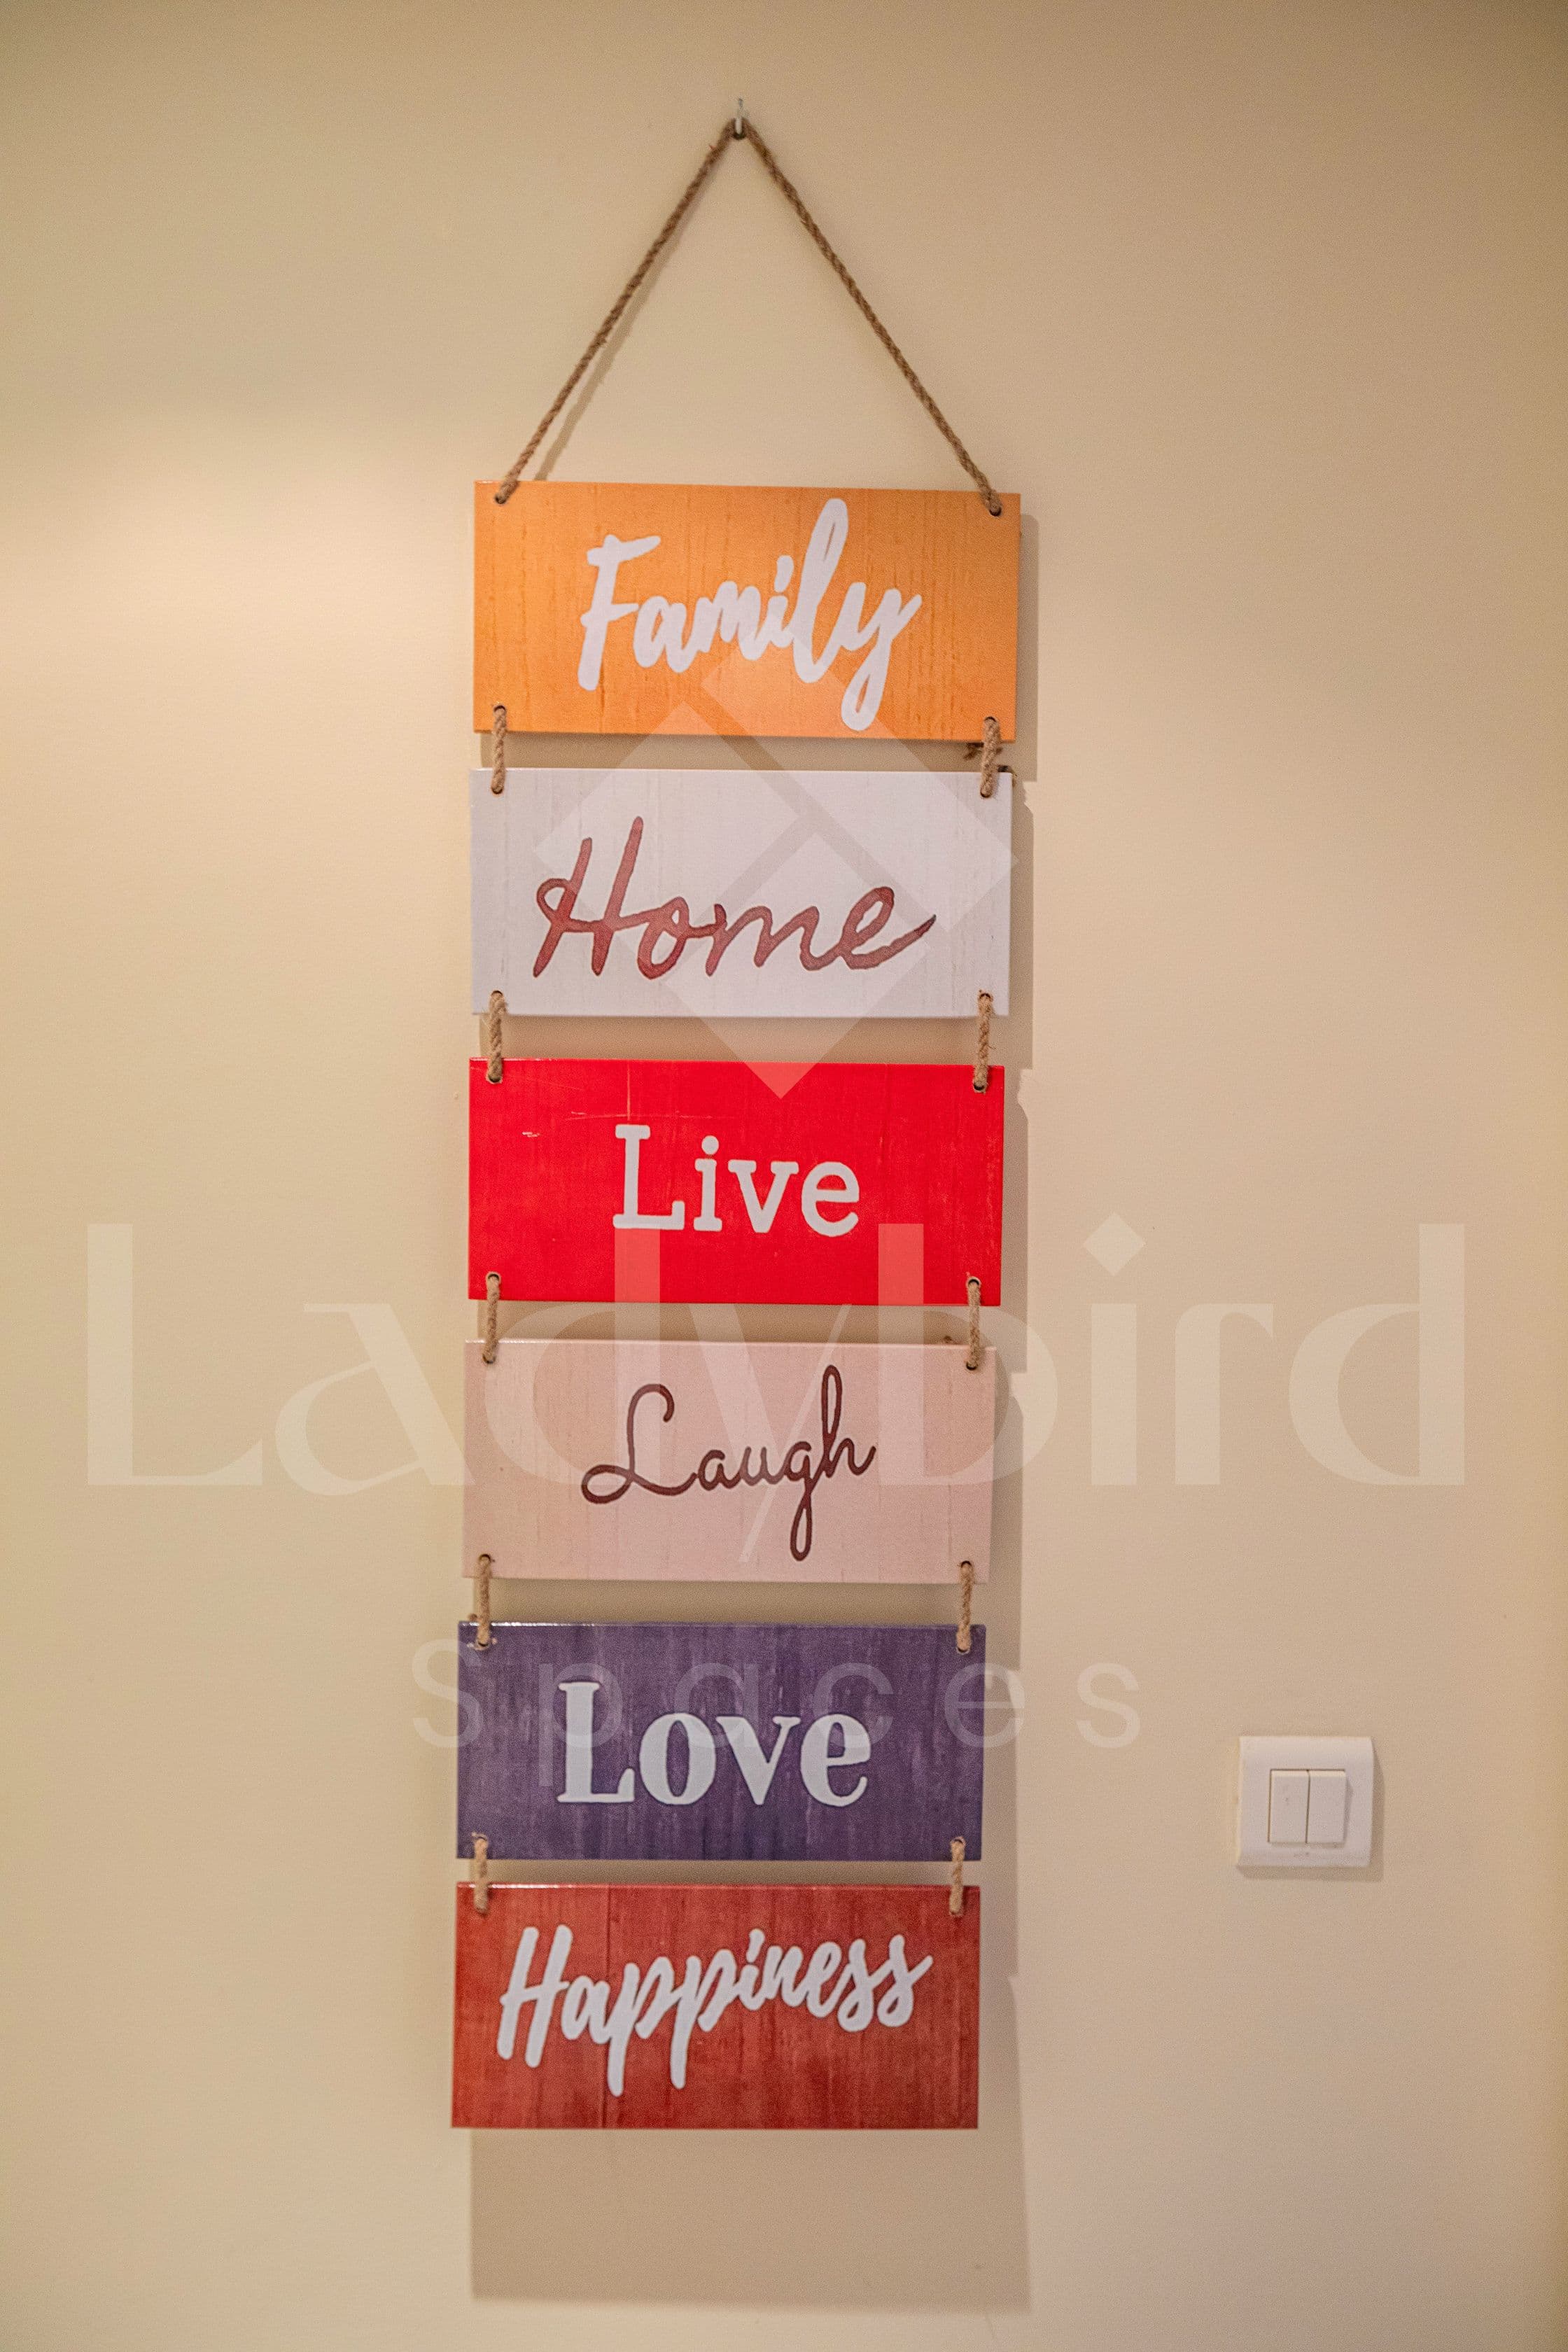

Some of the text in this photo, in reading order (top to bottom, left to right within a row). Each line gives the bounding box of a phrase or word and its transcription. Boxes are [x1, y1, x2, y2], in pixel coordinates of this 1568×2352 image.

[578, 498, 922, 732] Family
[533, 817, 936, 979] Home
[612, 1124, 860, 1237] Live
[582, 1364, 875, 1561] Laugh
[557, 1681, 872, 1807] Love
[497, 1925, 933, 2097] Happiness
